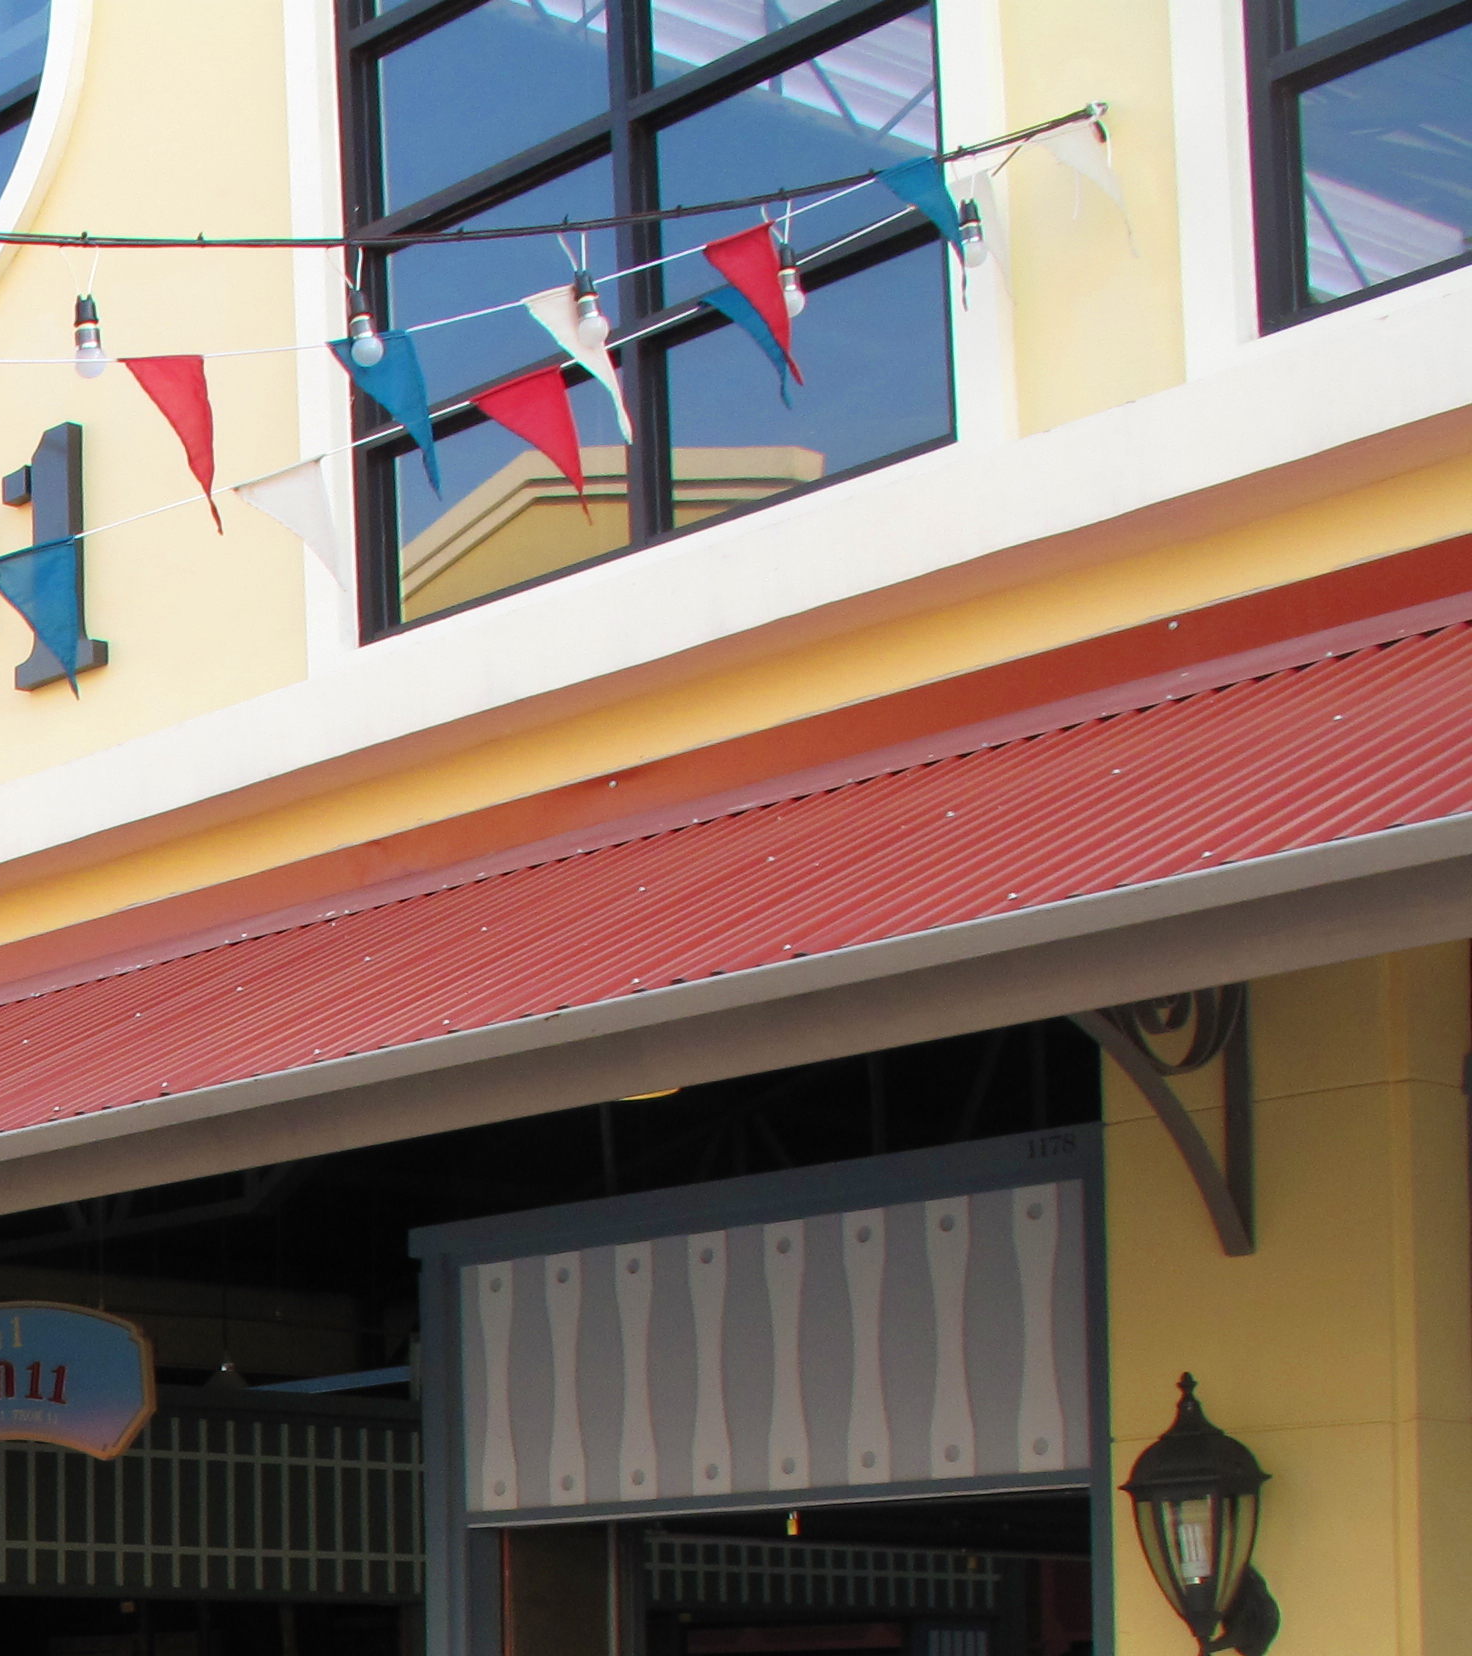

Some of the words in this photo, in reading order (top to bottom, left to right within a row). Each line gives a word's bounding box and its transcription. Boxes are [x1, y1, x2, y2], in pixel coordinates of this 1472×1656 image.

[2, 422, 108, 690] 1
[10, 1316, 23, 1348] 1
[25, 1360, 67, 1404] 11
